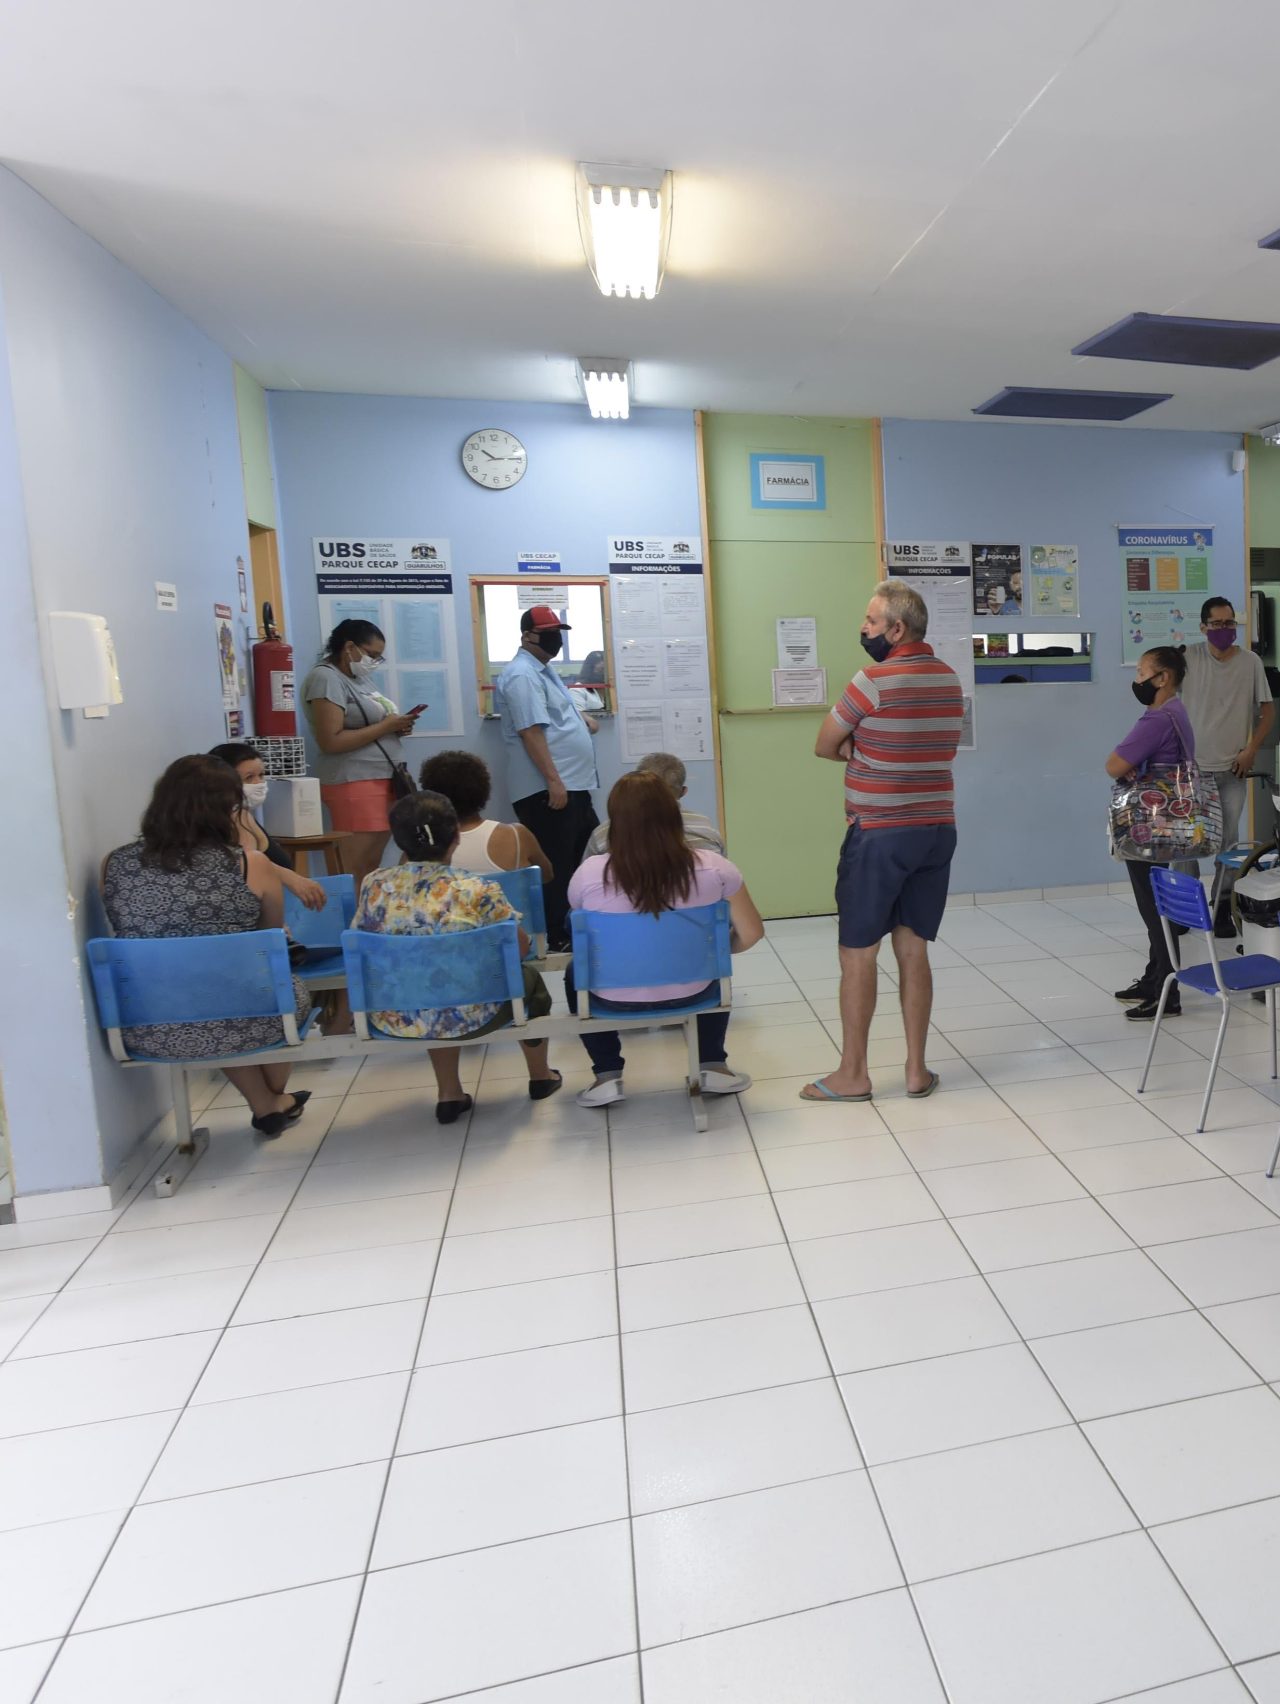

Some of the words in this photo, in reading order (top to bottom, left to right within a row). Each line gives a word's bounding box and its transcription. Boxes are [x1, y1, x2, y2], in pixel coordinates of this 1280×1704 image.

[766, 476, 810, 486] FARMÁCIA
[1125, 535, 1188, 545] CORONAVÍRUS
[319, 542, 366, 558] UBS
[614, 540, 645, 552] UBS
[893, 545, 920, 555] UBS
[321, 560, 365, 569] PARQUE
[367, 560, 399, 569] CECAP
[631, 564, 681, 573] INFORMAÇÕES
